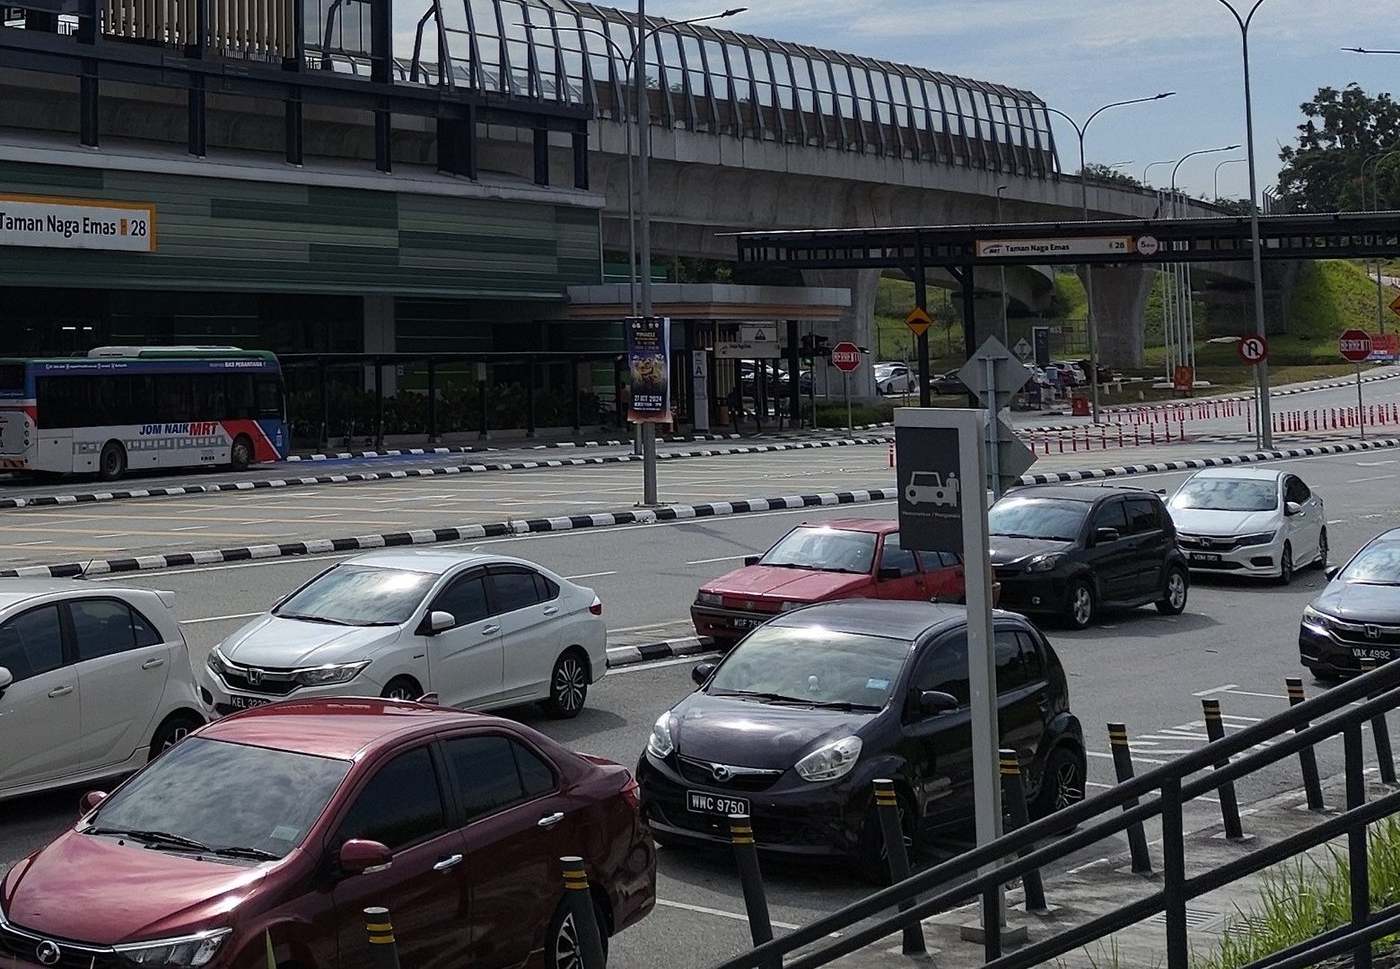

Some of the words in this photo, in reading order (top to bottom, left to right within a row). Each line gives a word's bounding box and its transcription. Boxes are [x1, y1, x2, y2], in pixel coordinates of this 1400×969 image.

[47, 215, 80, 238] Naga
[83, 217, 116, 236] Emas
[130, 219, 146, 237] 28
[1005, 245, 1029, 253] Taman
[1030, 244, 1049, 253] Naga
[1050, 243, 1070, 251] Emas
[695, 365, 703, 375] A
[139, 425, 162, 435] JOM
[164, 423, 189, 434] NAIK
[189, 422, 218, 436] MRT
[1352, 648, 1367, 658] VAK
[1369, 649, 1391, 660] 4992
[231, 696, 247, 708] KEL
[692, 794, 714, 810] WWC
[716, 799, 745, 814] 9750
